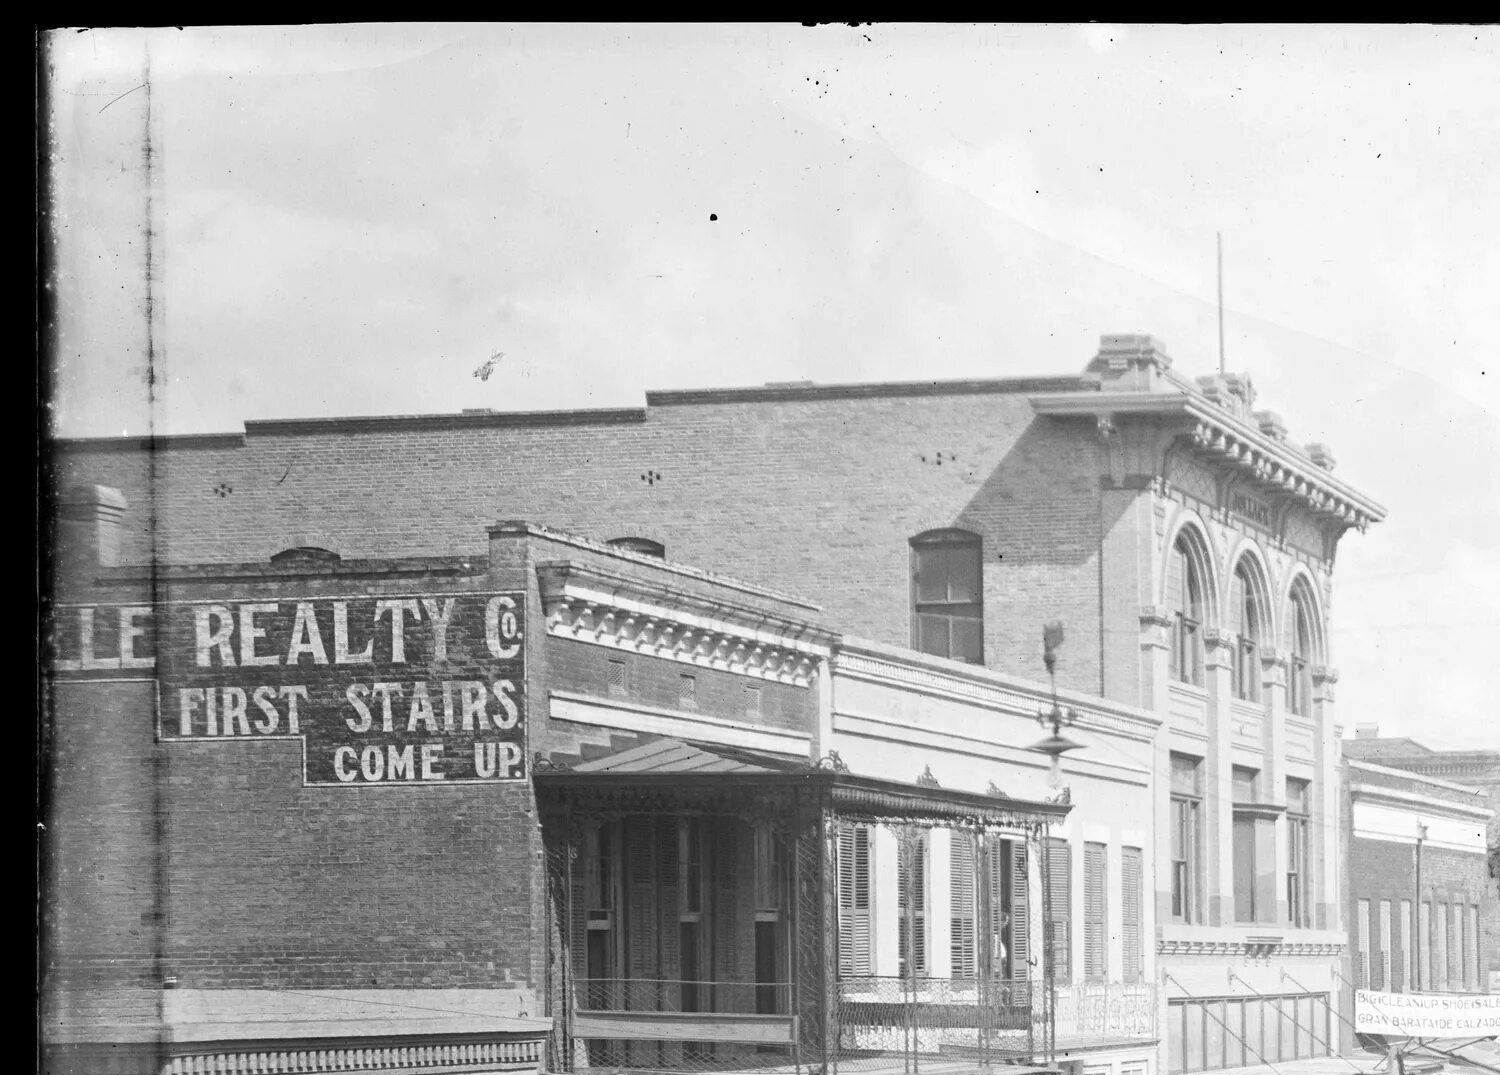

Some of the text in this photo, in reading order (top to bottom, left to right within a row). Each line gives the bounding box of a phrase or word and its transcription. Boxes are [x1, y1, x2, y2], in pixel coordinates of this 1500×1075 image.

[195, 598, 455, 666] REALTY
[179, 686, 308, 735] FIRST
[334, 742, 522, 782] COME UP.
[1358, 1013, 1389, 1025] GRAN
[1392, 1016, 1434, 1029] BARATA
[1439, 1018, 1453, 1029] DE
